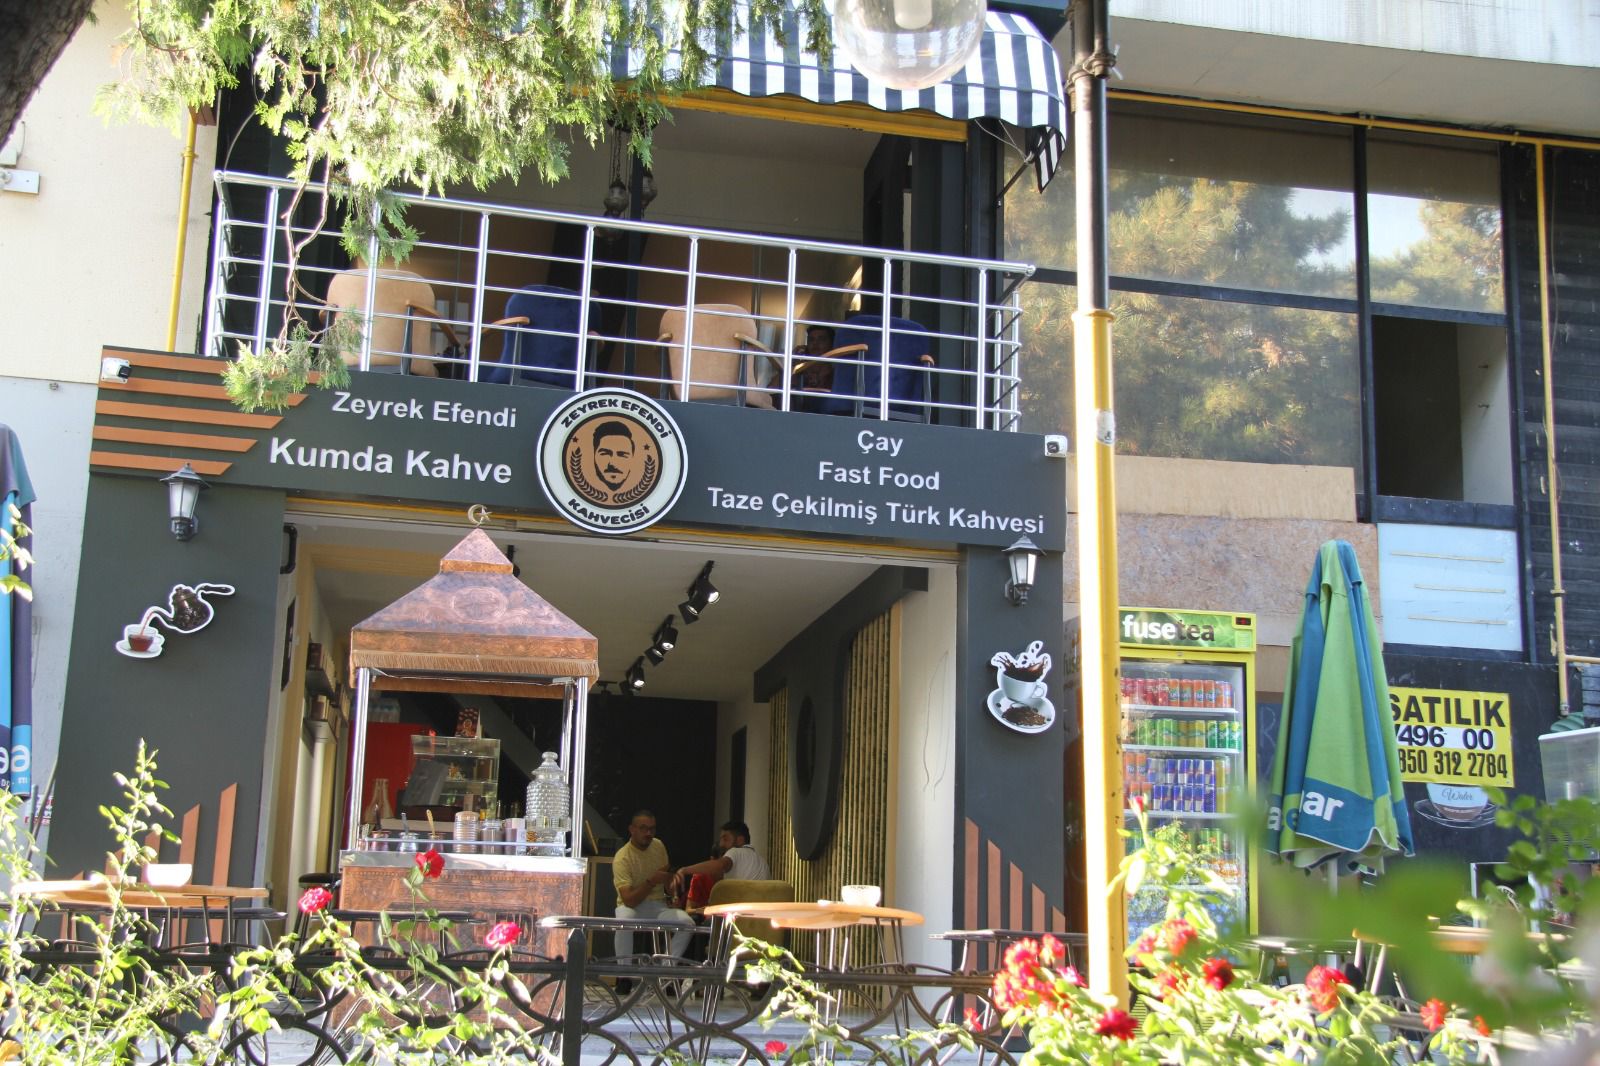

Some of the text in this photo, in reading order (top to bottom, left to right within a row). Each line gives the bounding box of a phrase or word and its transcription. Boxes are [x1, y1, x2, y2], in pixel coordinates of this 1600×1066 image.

[332, 391, 517, 428] Zeyrek Efendi
[561, 399, 673, 439] ZEYREK EFENDİ
[857, 430, 903, 457] Çay
[269, 437, 512, 484] Kumda Kahve
[818, 461, 940, 491] Fast Food
[568, 498, 651, 525] KAHVECİSİ
[707, 487, 1045, 534] Taze Çekilmiş Türk Kahvesi
[1462, 728, 1494, 751] 00
[1434, 750, 1462, 776] 312
[1467, 752, 1508, 779] 2784
